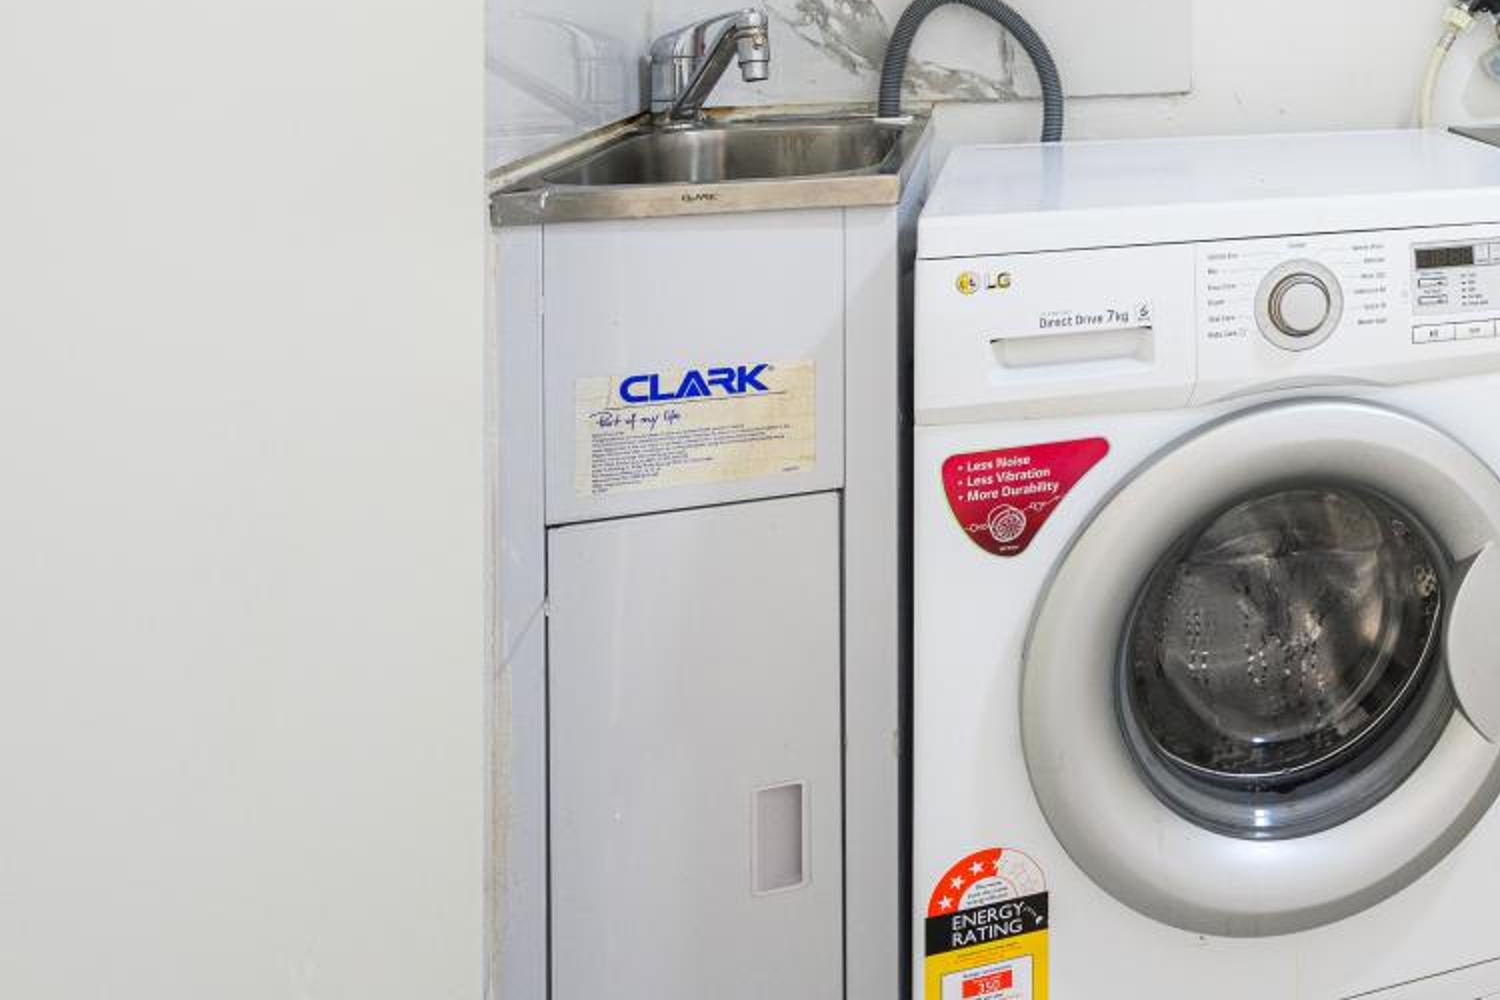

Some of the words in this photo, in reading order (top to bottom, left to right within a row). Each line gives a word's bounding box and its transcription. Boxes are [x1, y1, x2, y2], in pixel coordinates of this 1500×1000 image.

[985, 272, 1012, 290] LG
[1038, 313, 1073, 329] Direct
[1075, 311, 1104, 326] Drive
[1106, 309, 1130, 324] 7kg
[619, 363, 769, 404] CLARK
[624, 412, 637, 430] of
[640, 415, 660, 431] my
[966, 460, 994, 473] Less
[995, 455, 1031, 468] Noise
[966, 474, 994, 487] Less
[996, 468, 1051, 483] Vibration
[966, 489, 999, 502] More
[1001, 481, 1059, 497] Durability
[951, 901, 1025, 931] ENERGY
[951, 918, 1024, 947] RATING
